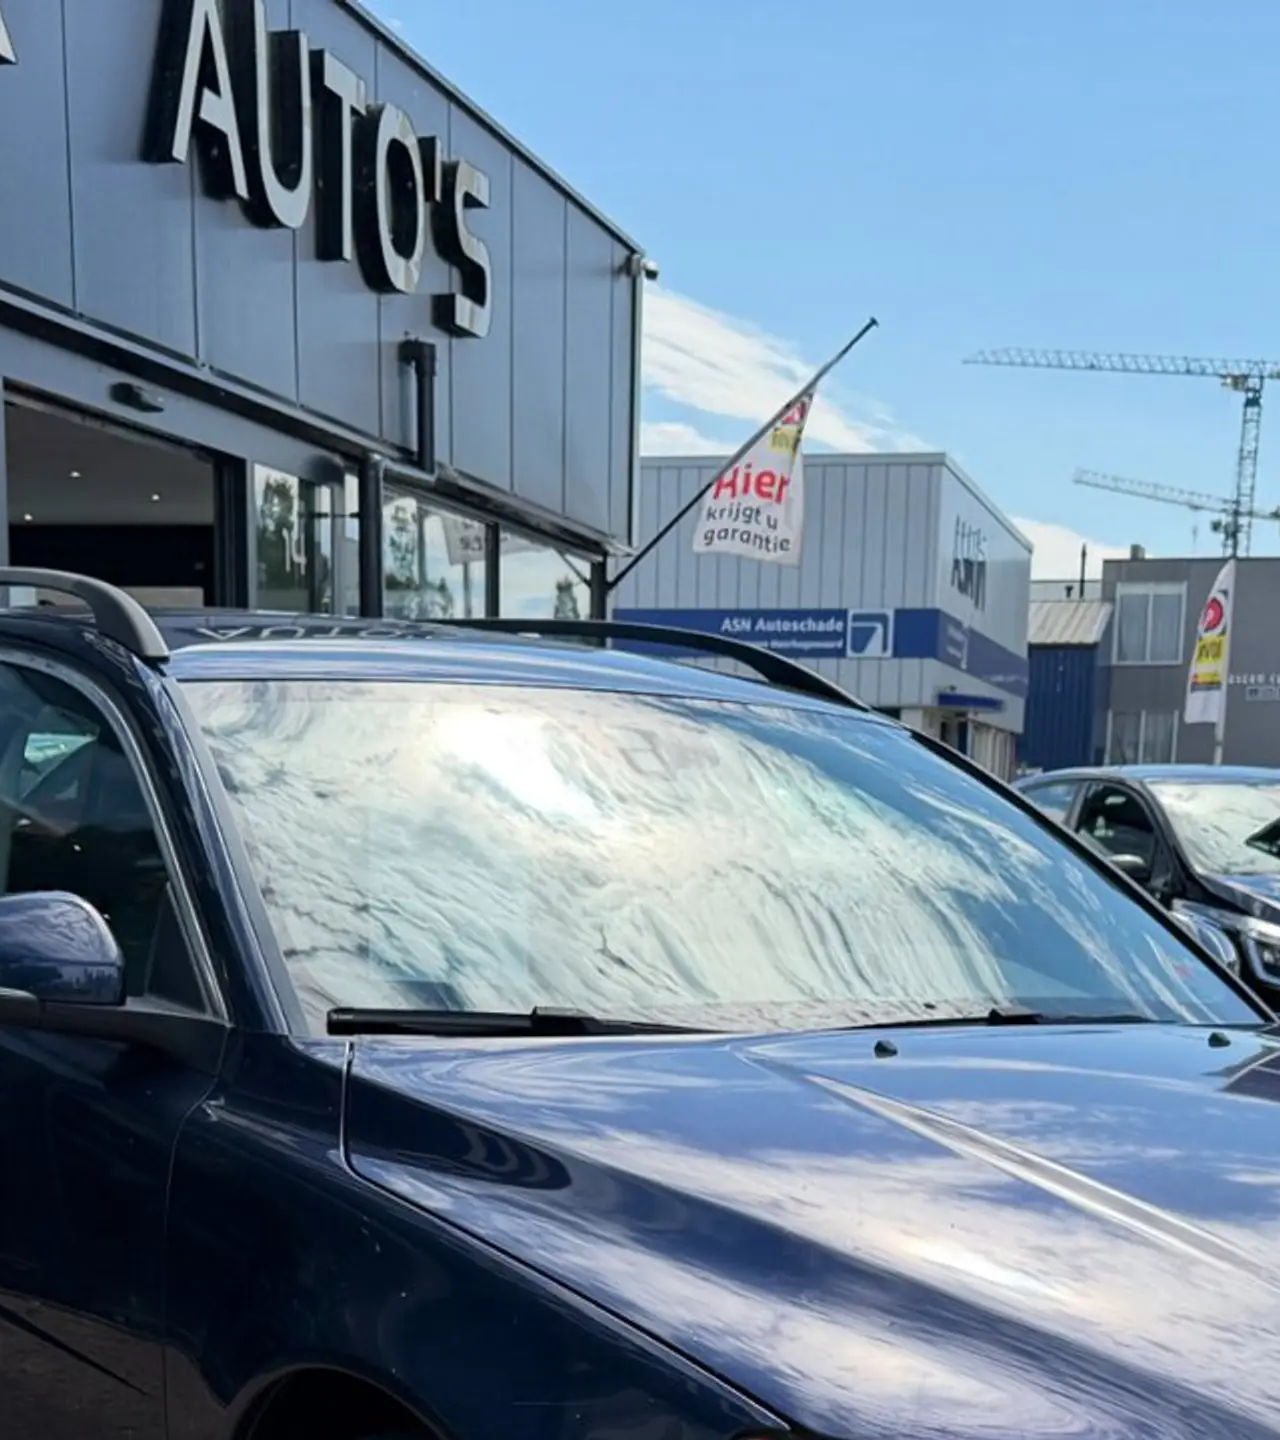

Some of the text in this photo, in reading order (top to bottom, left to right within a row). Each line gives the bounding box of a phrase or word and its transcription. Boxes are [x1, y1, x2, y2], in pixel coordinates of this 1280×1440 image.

[142, 0, 491, 338] AUTO'S
[713, 462, 791, 503] Hier
[707, 503, 778, 529] krijgt u
[704, 527, 791, 553] garantie
[721, 616, 845, 633] ASN Autoschade
